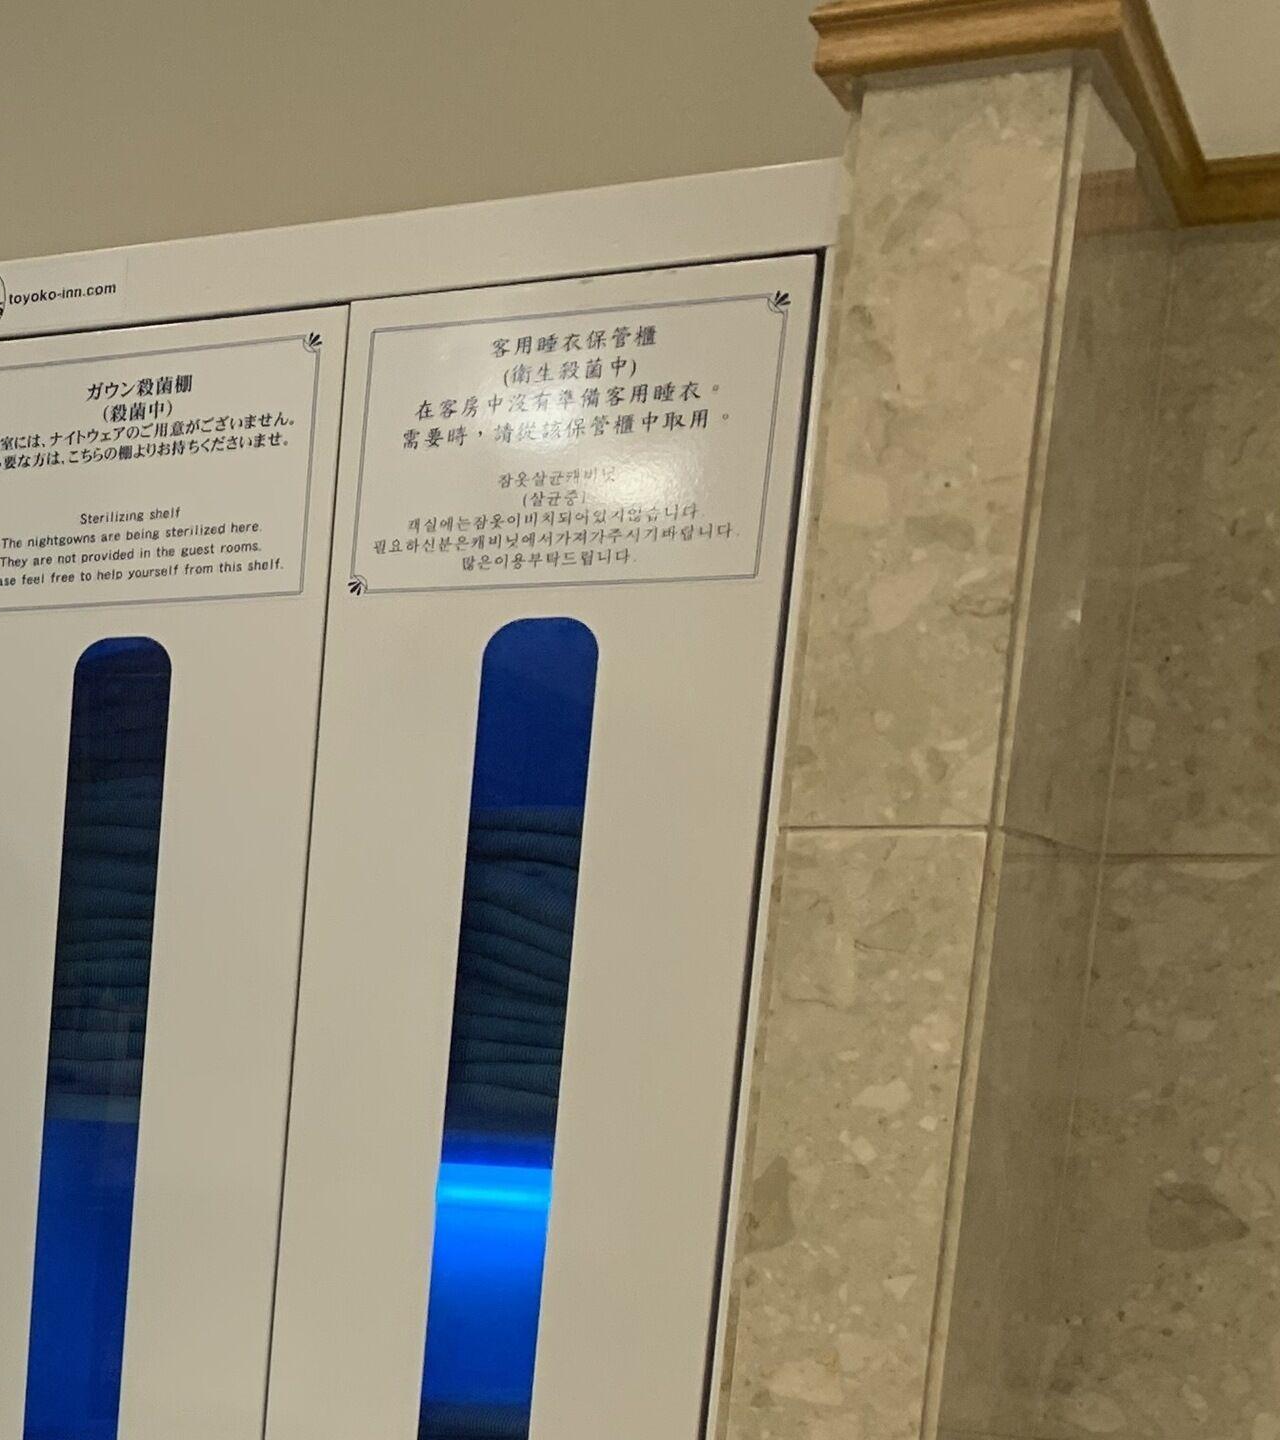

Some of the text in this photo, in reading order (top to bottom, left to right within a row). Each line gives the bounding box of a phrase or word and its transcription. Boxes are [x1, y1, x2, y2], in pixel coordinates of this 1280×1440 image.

[8, 282, 117, 305] toyoko-inn.com
[85, 374, 193, 402] ガウン殺菌棚
[80, 506, 181, 526] Sterilizing shelf
[1, 521, 263, 550] The nightgowns are being sterilized here.
[0, 541, 262, 571] They are not provided in the guest rooms.
[21, 572, 45, 585] feel
[50, 570, 75, 584] free
[80, 569, 92, 581] to
[97, 567, 122, 583] help
[128, 565, 179, 582] yourself
[184, 563, 213, 577] from
[219, 560, 242, 574] this
[247, 557, 284, 573] shelf.
